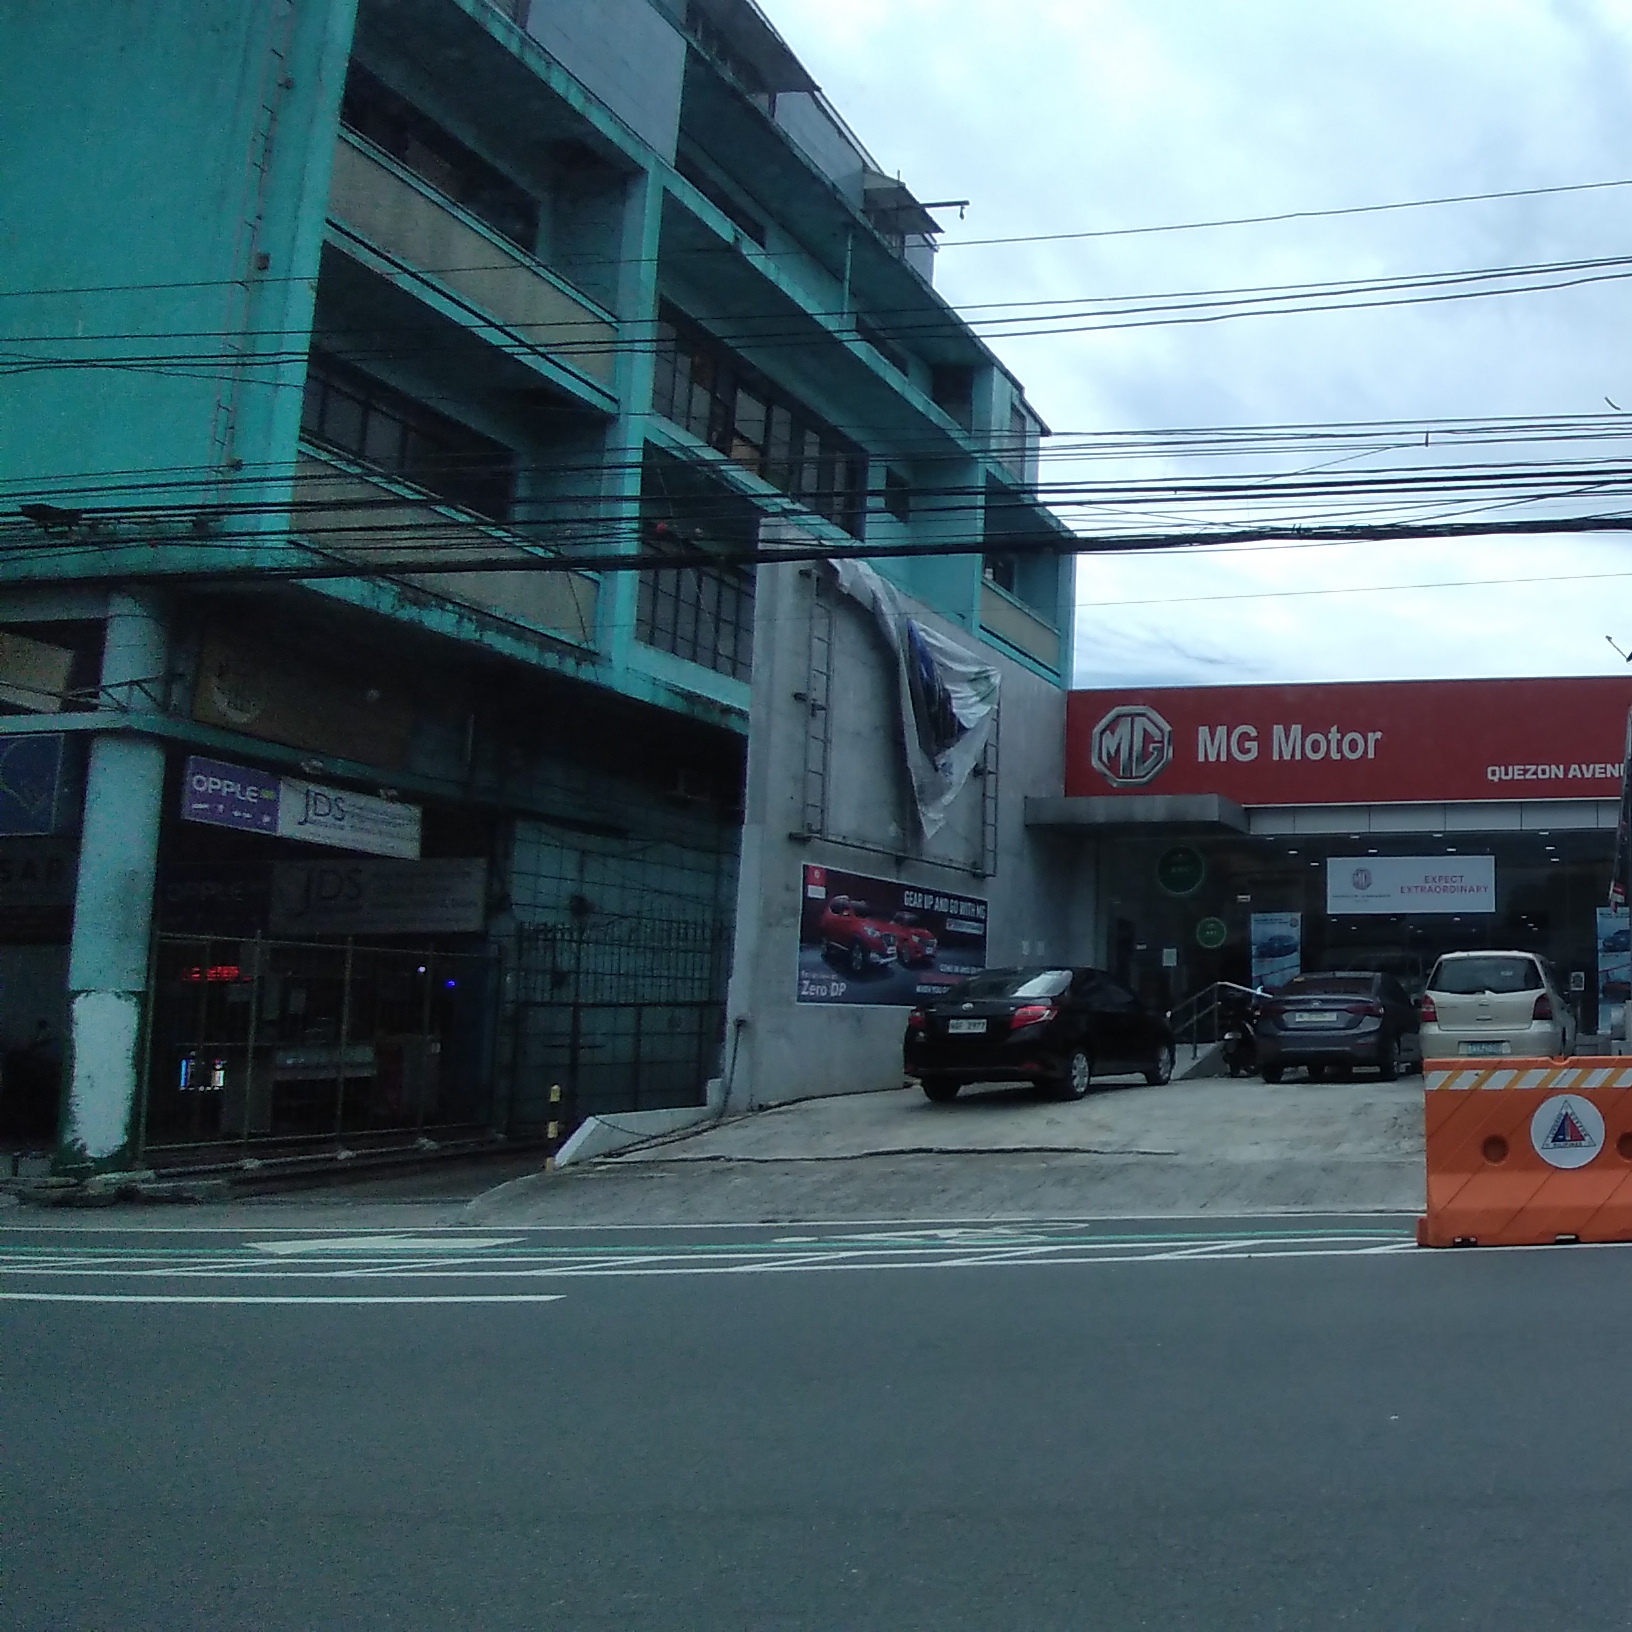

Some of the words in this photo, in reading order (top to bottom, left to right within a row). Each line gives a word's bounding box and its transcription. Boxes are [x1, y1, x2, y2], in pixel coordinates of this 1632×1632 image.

[1098, 713, 1165, 780] MG
[1197, 725, 1259, 762] MG
[1272, 724, 1383, 761] Motor
[1486, 764, 1564, 782] QUEZON
[191, 774, 260, 803] OPPLE
[298, 788, 346, 826] JDS
[1400, 885, 1489, 894] EXTRAORDINARY
[1424, 875, 1465, 884] EXPECT
[904, 890, 923, 908] GEAR
[924, 894, 934, 910] UP
[801, 980, 828, 996] Zero
[830, 981, 847, 997] DP
